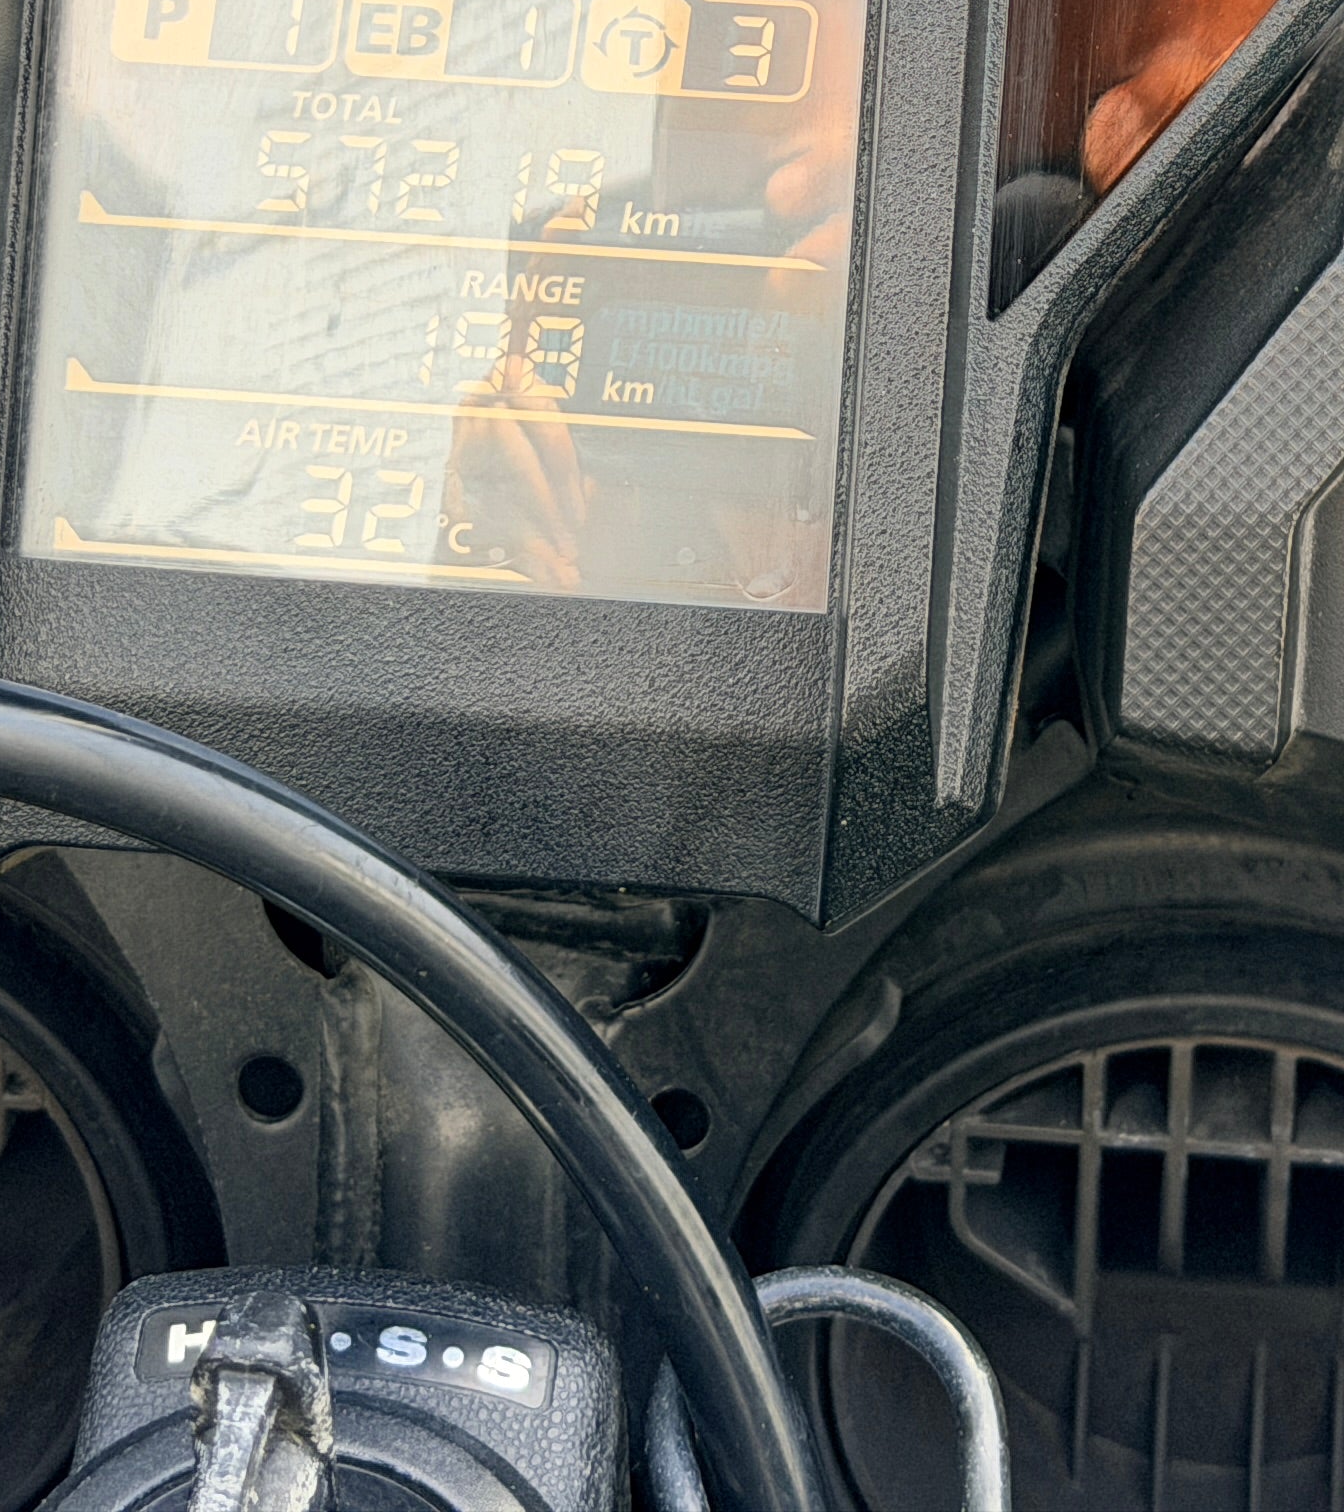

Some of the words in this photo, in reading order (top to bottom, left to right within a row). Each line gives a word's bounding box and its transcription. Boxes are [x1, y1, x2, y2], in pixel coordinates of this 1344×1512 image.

[356, 4, 442, 56] EB
[520, 4, 539, 71] 1
[619, 27, 665, 65] T
[727, 15, 774, 88] 3
[292, 90, 403, 125] TOTAL
[621, 201, 681, 238] km
[460, 270, 586, 305] RANGE
[417, 312, 585, 400] 198
[602, 371, 655, 405] km
[237, 417, 303, 451] AIR
[309, 422, 409, 458] TEMP
[295, 465, 424, 554] 32
